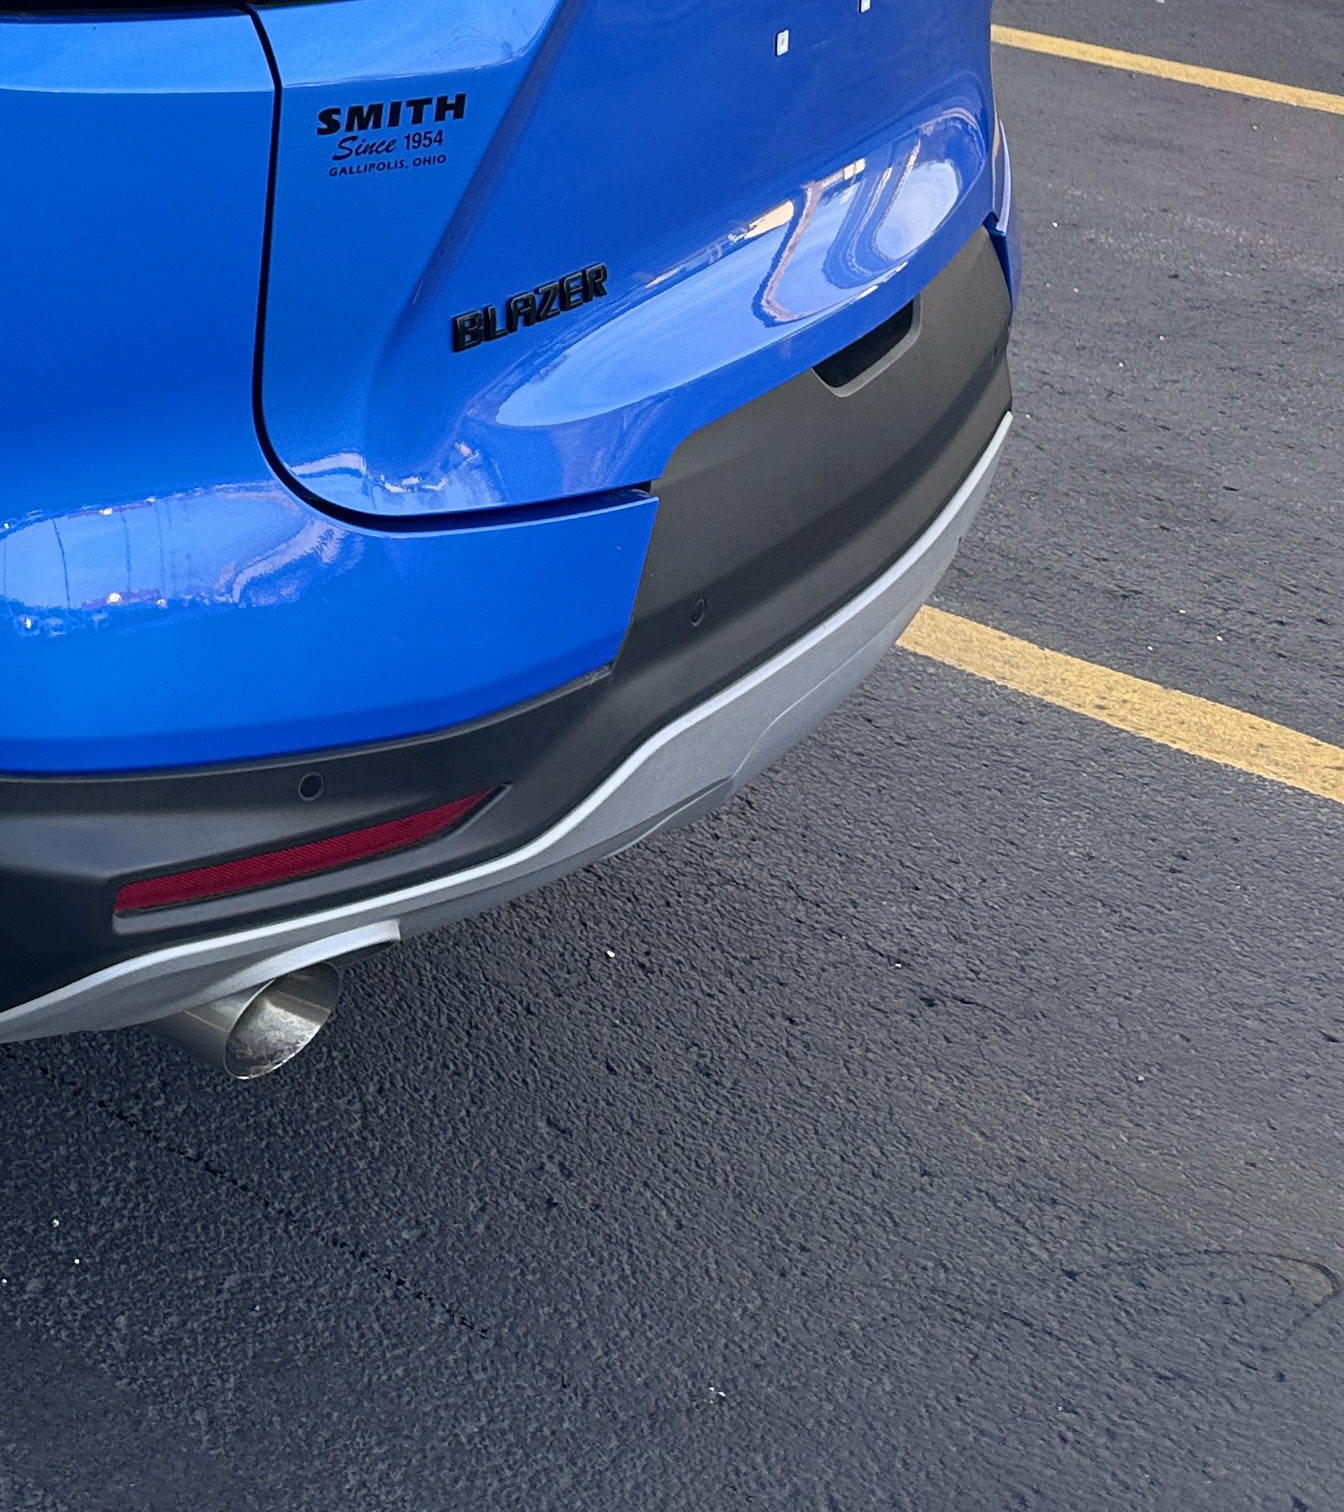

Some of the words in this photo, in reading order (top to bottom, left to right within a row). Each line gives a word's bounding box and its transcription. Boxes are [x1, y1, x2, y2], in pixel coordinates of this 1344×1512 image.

[317, 93, 466, 135] SMITH
[332, 135, 396, 161] Since
[404, 129, 444, 150] 1954
[329, 159, 408, 177] GALLIPOLIS,
[413, 154, 447, 167] OHIO
[451, 262, 608, 353] BLAZER
